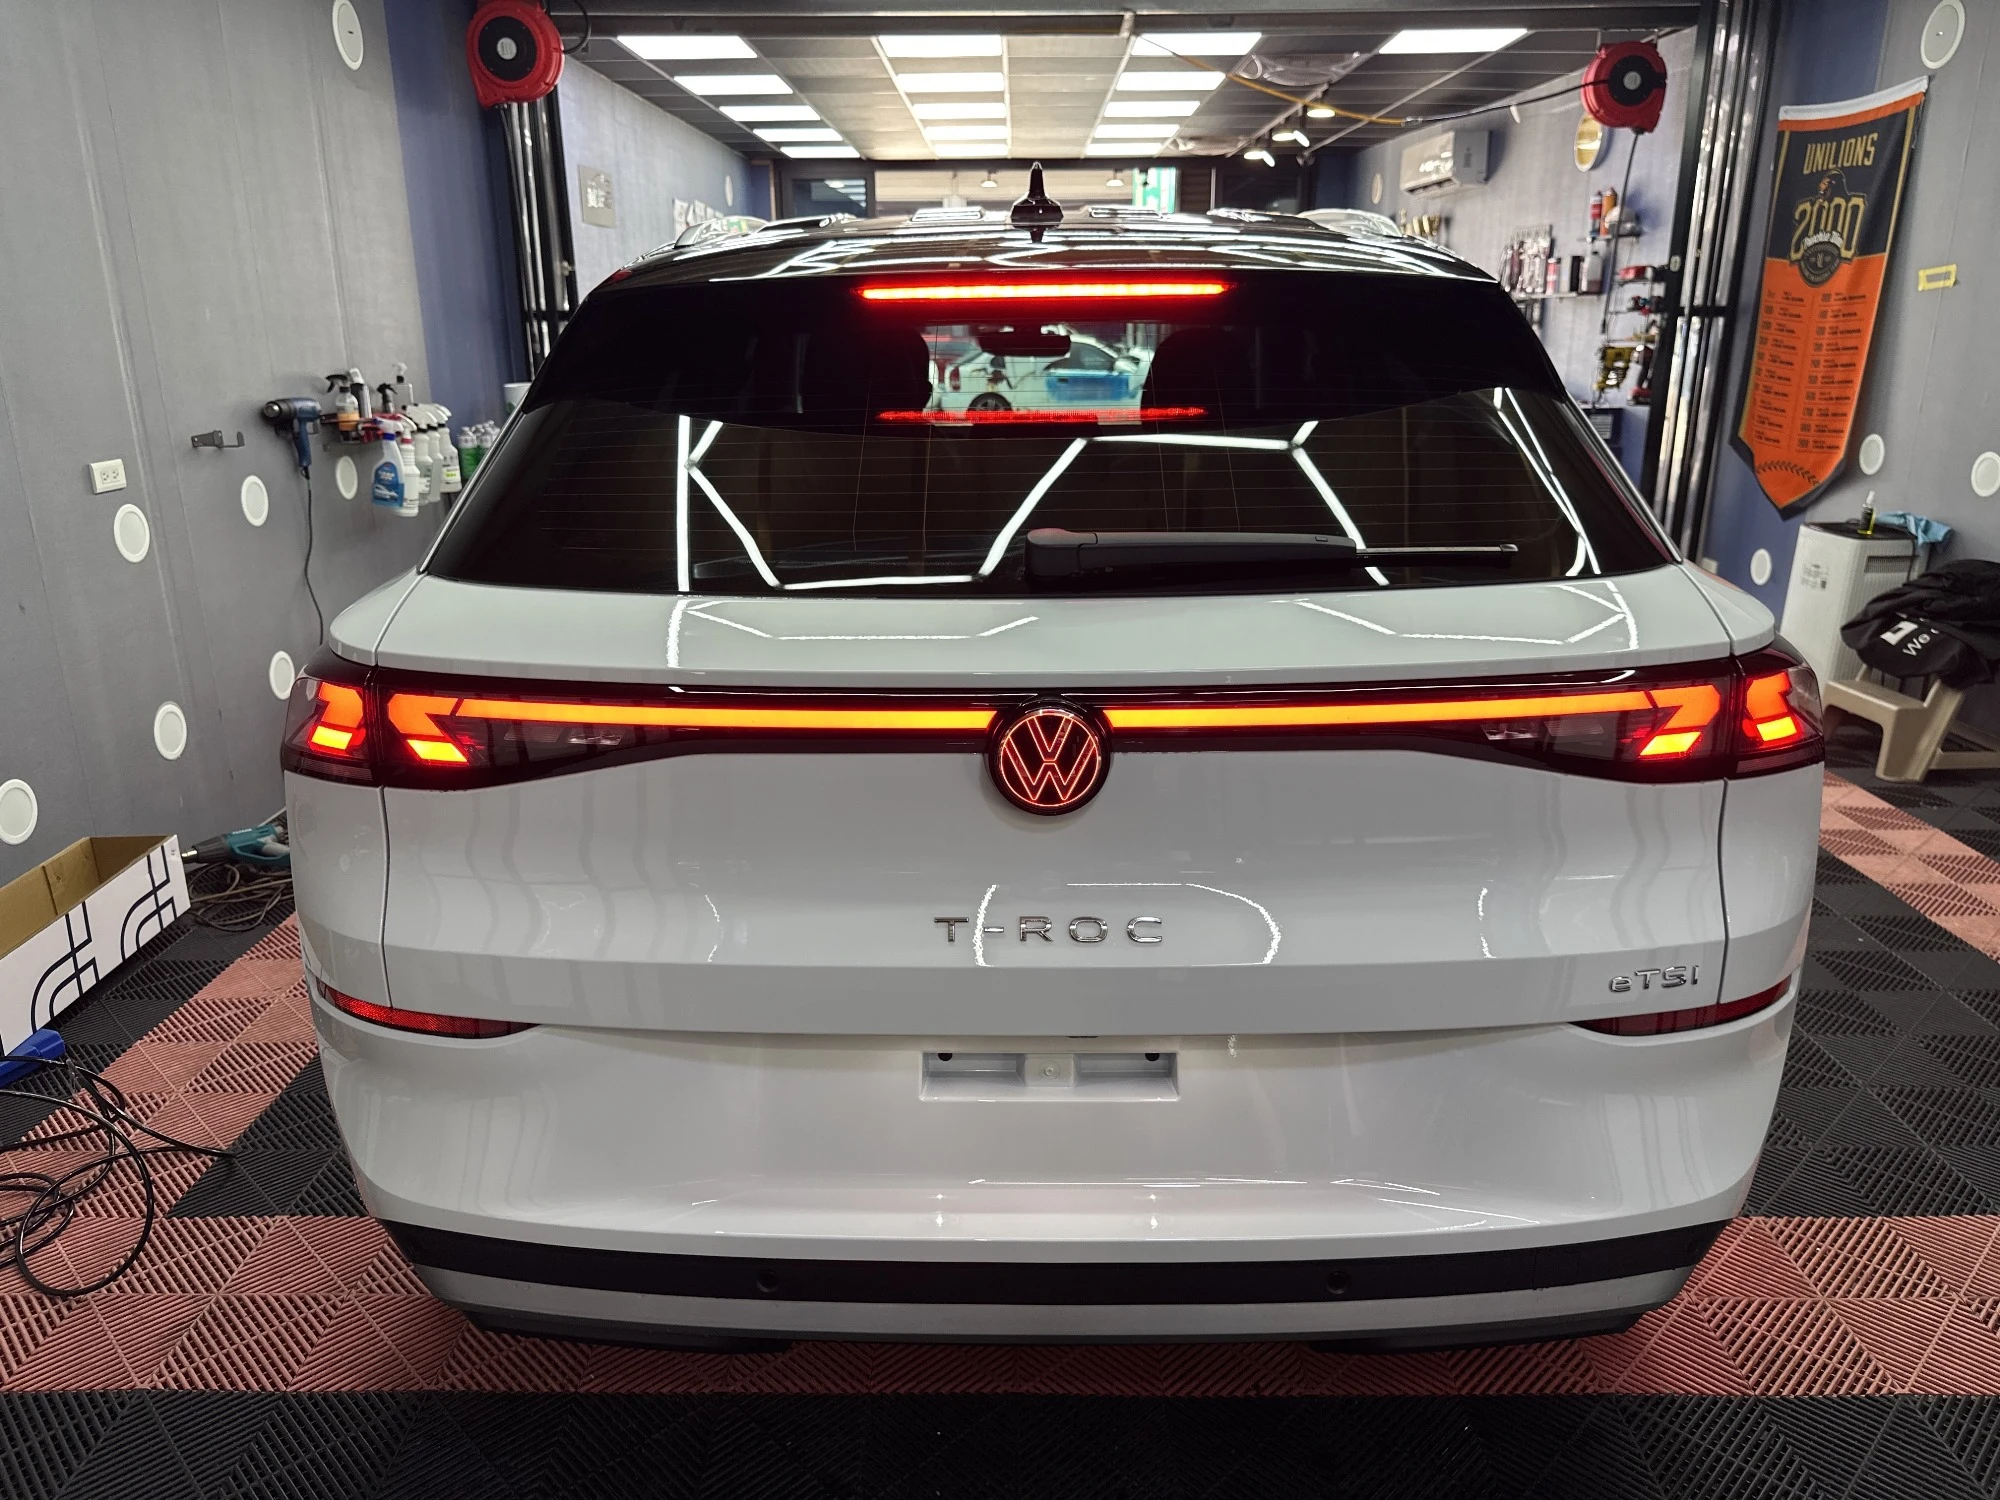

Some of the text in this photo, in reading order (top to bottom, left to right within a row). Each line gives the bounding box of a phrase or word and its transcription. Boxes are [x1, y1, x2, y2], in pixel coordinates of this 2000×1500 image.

[1803, 132, 1878, 174] UNILIONS
[1790, 196, 1865, 262] 2000
[934, 916, 1163, 944] T-ROC
[1610, 965, 1700, 992] eTSI
